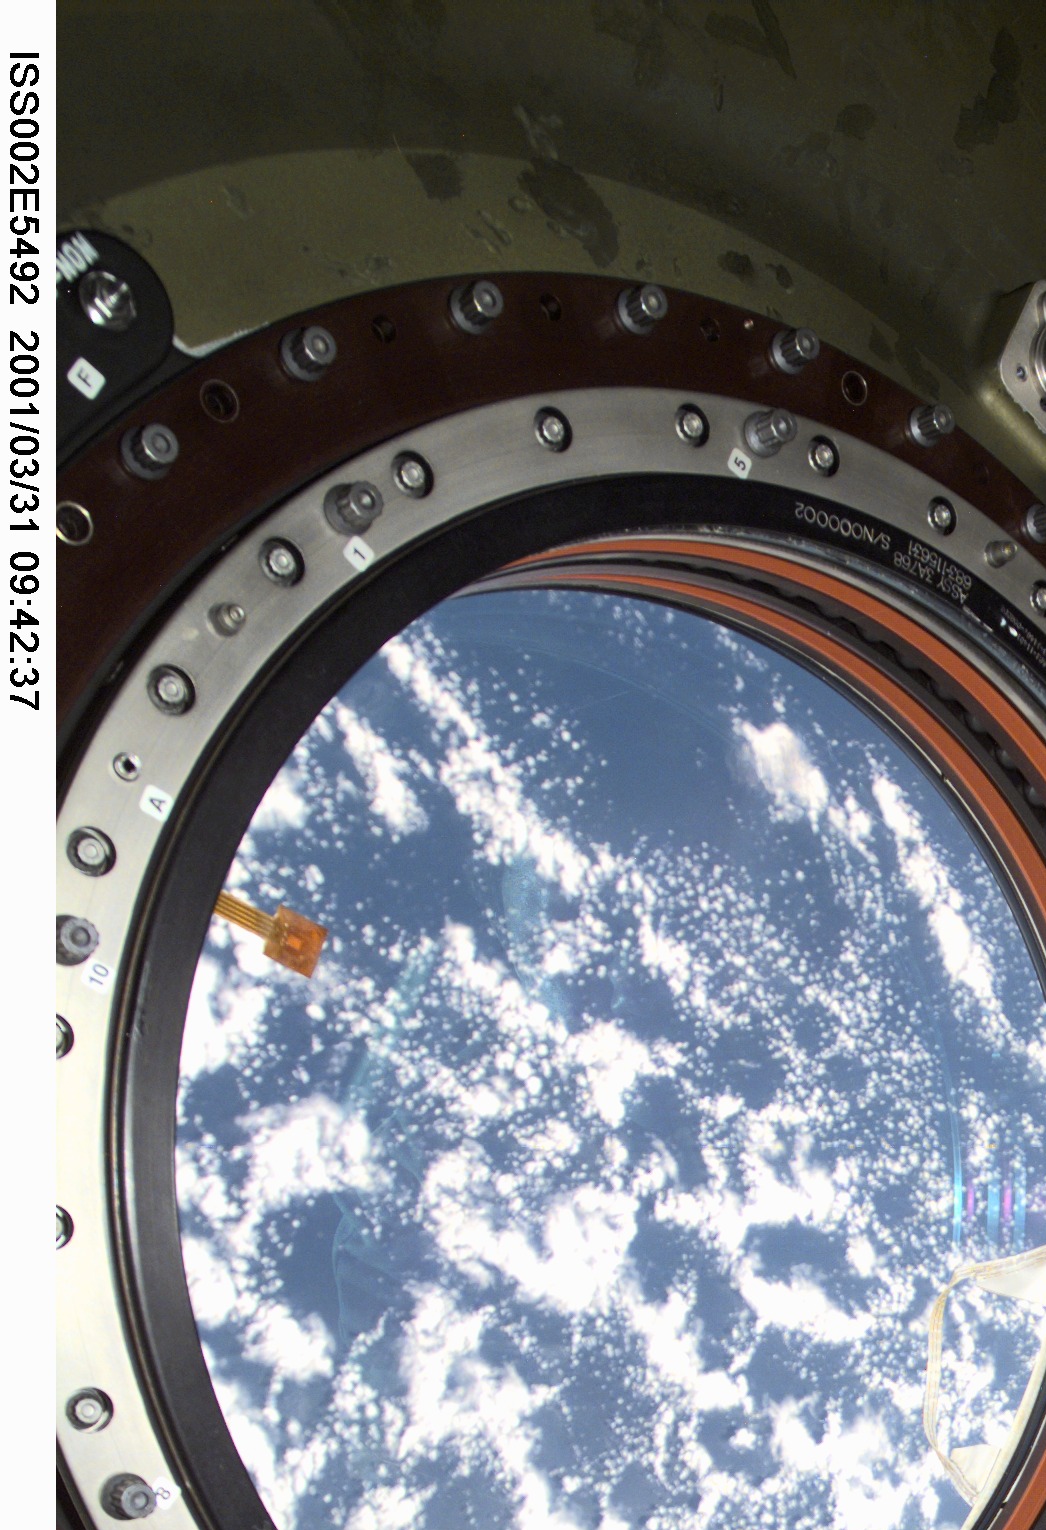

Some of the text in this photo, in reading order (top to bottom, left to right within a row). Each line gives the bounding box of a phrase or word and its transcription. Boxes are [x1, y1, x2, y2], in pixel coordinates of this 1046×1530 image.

[76, 368, 93, 389] F
[734, 456, 748, 471] 5
[353, 547, 366, 562] 1
[936, 576, 969, 604] ASSY
[149, 796, 167, 813] A
[88, 963, 110, 987] 10
[156, 1487, 171, 1500] 8
